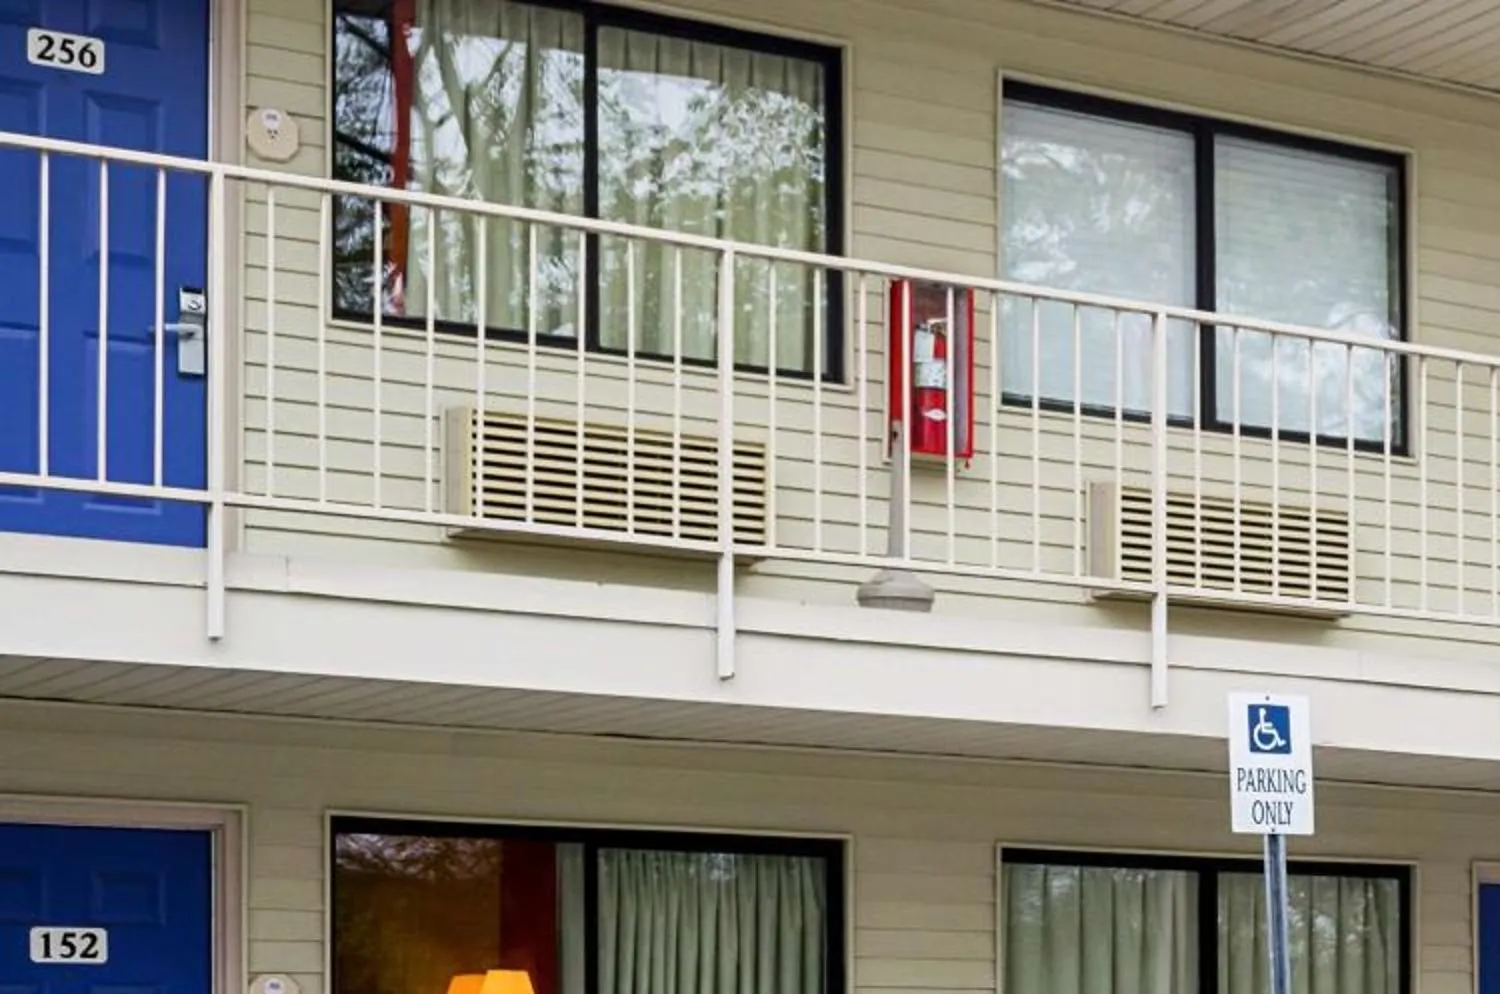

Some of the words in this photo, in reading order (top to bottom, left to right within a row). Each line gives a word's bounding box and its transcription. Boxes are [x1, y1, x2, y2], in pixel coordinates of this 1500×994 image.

[36, 34, 97, 68] 256
[1236, 767, 1306, 794] PARKING
[1251, 800, 1294, 825] ONLY
[39, 932, 99, 959] 152
